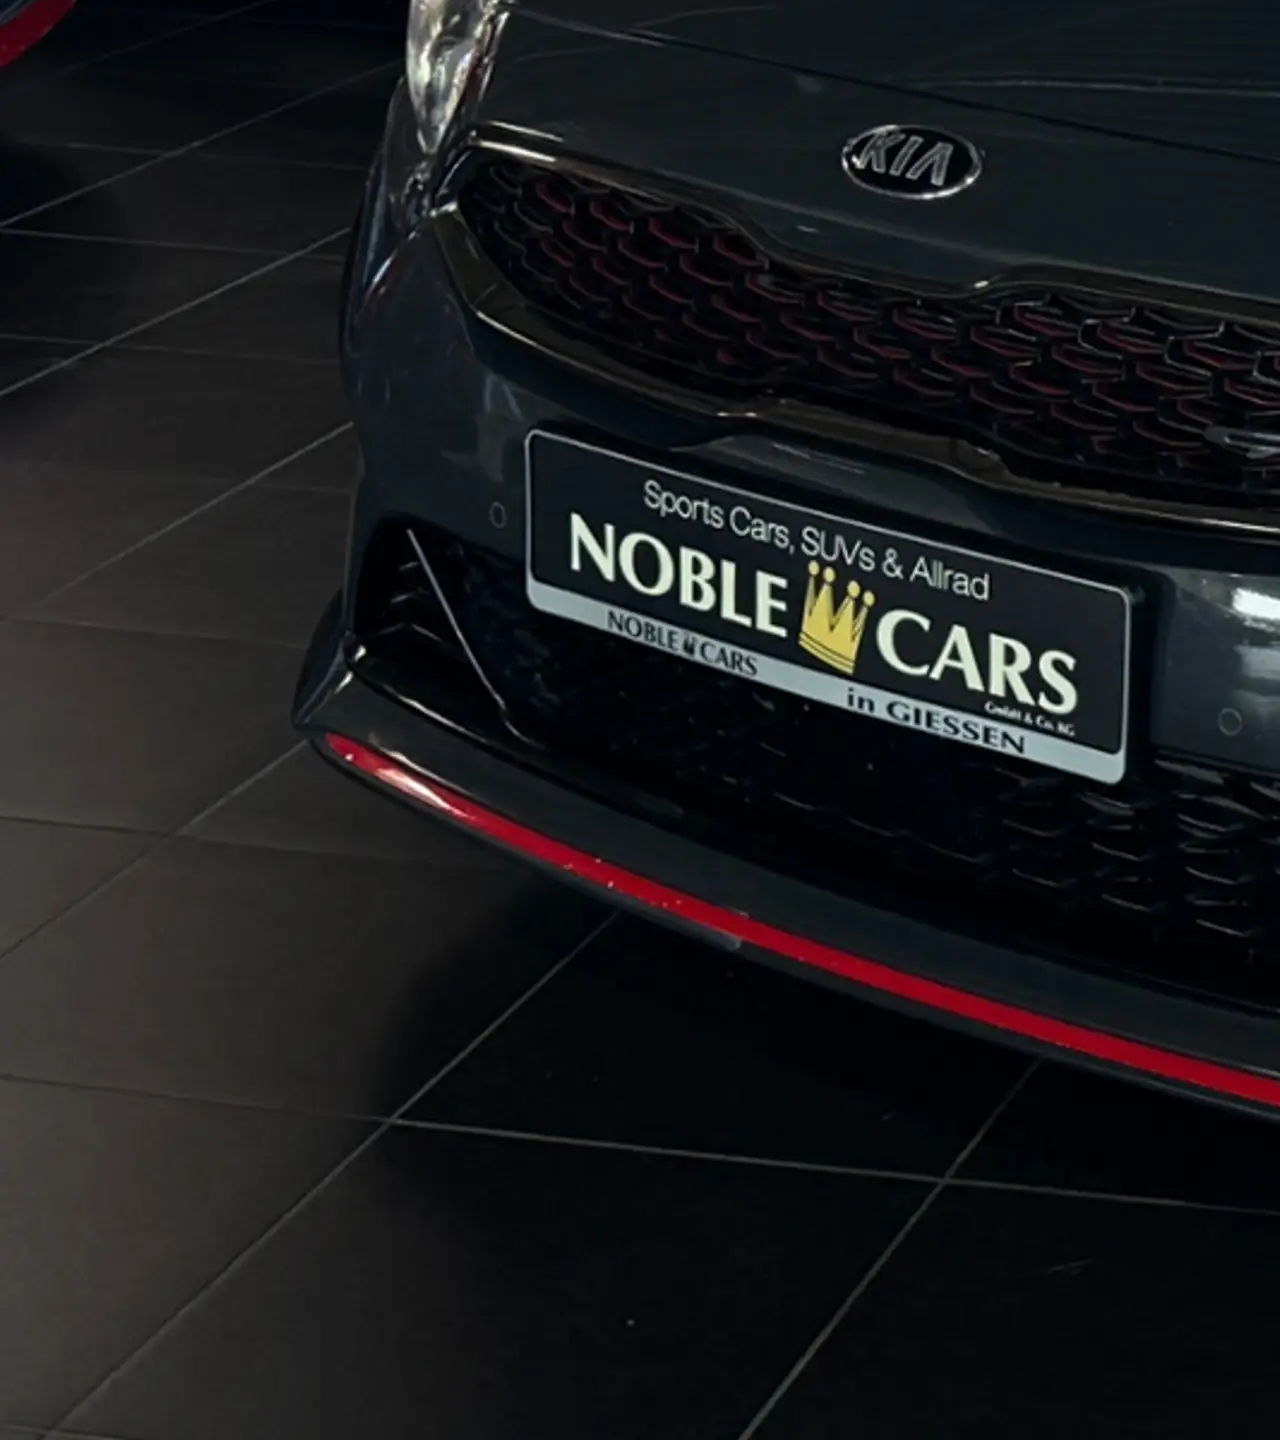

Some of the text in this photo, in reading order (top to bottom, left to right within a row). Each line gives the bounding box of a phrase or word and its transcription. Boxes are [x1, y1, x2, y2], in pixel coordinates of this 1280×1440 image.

[851, 131, 955, 187] KIA
[643, 479, 990, 601] Sports Cars, SUVs & Allrad
[570, 511, 1078, 715] NOBLE CARS
[607, 609, 758, 676] NOBLE CARS
[847, 687, 1025, 754] in GIESSEN
